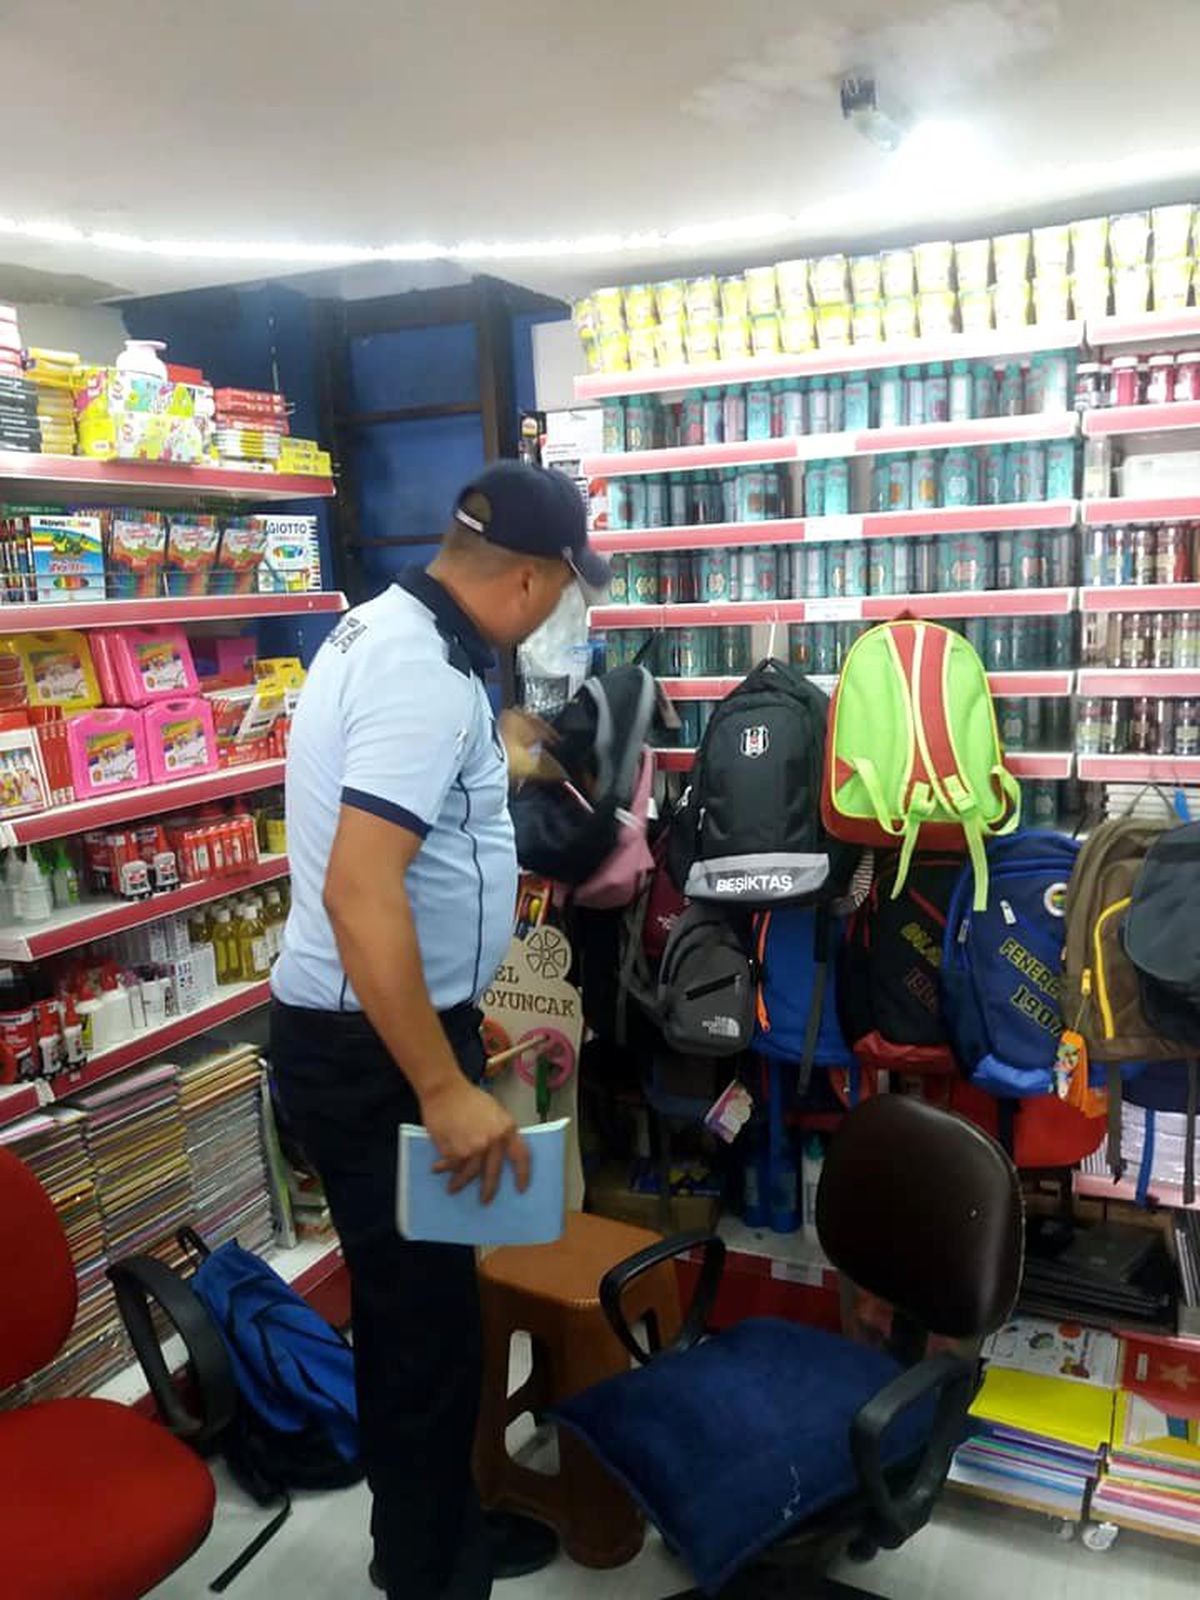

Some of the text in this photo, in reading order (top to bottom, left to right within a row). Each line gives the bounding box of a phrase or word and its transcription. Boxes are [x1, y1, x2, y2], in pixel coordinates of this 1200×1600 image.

[268, 522, 307, 534] GIOTTO
[495, 965, 519, 984] EL
[484, 988, 575, 1017] OYUNCAK
